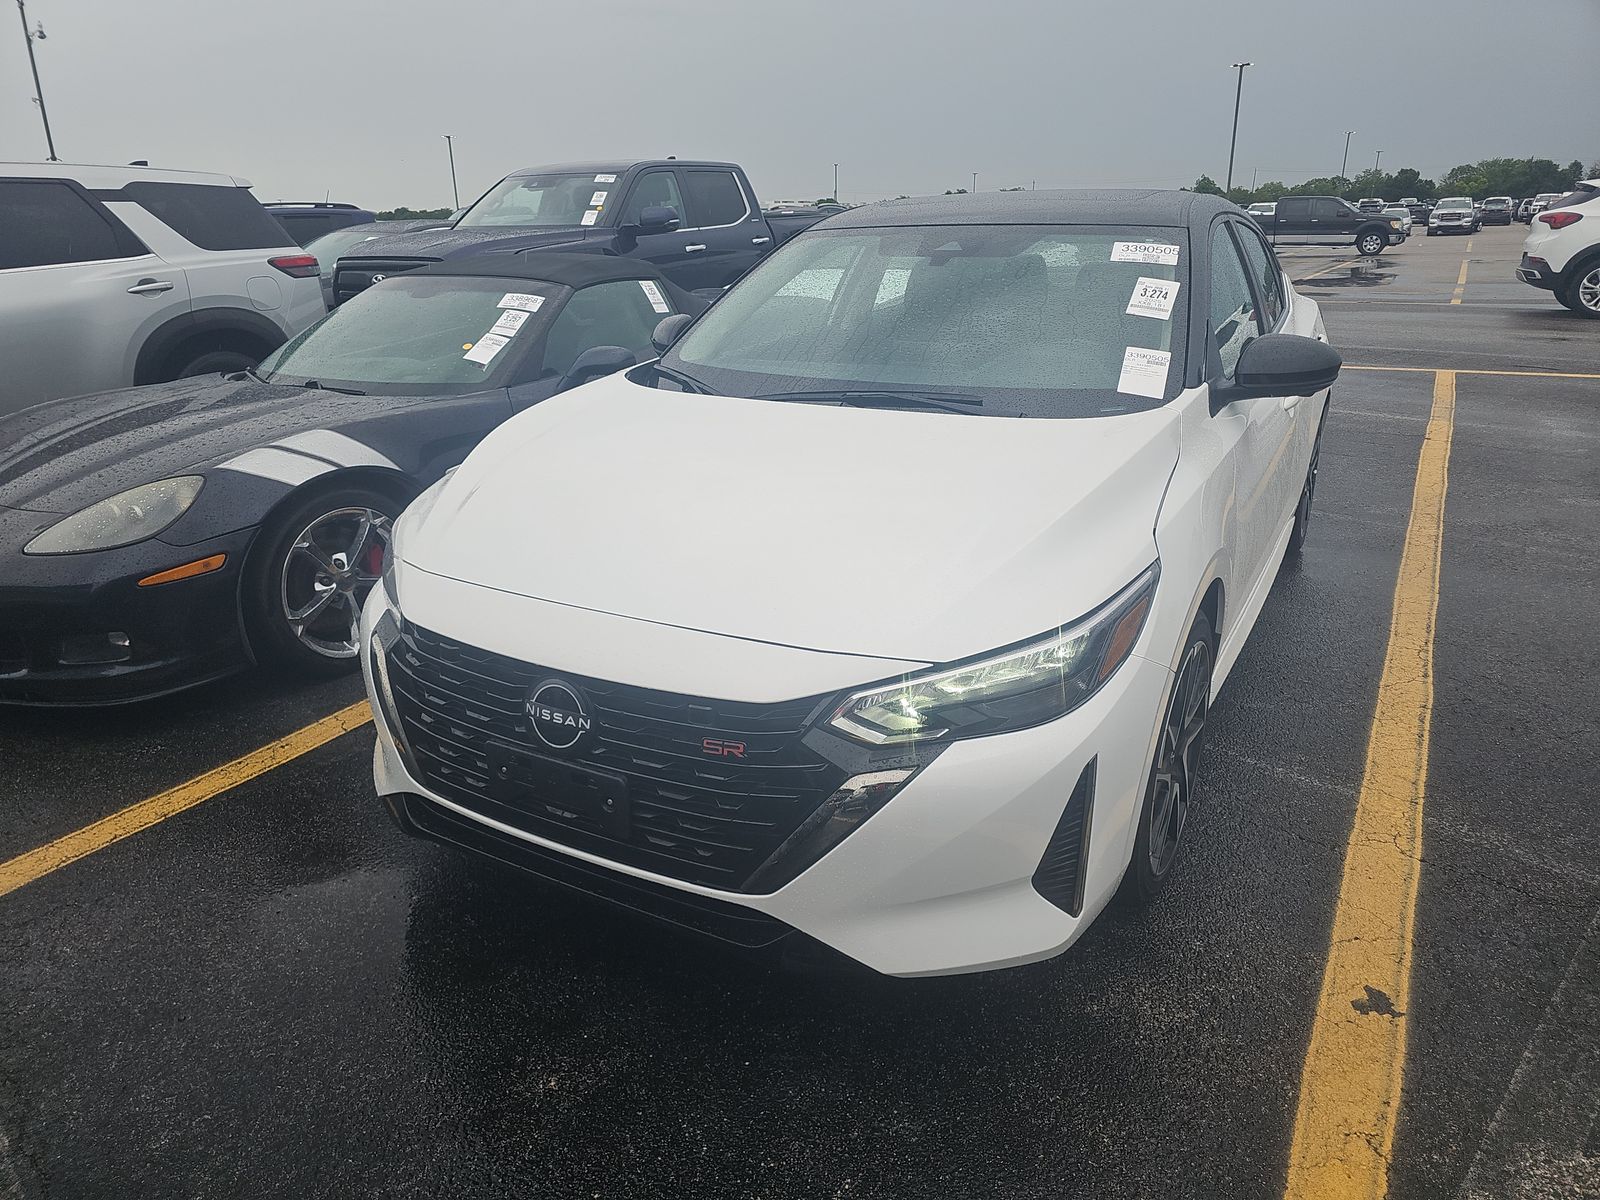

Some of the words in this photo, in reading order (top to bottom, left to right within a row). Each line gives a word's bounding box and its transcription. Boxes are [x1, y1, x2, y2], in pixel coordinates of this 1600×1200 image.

[1121, 245, 1179, 255] 3390505
[1140, 288, 1169, 300] 3:274
[1127, 352, 1170, 362] 3390505
[526, 702, 591, 730] NISSAN
[703, 739, 746, 758] SR
